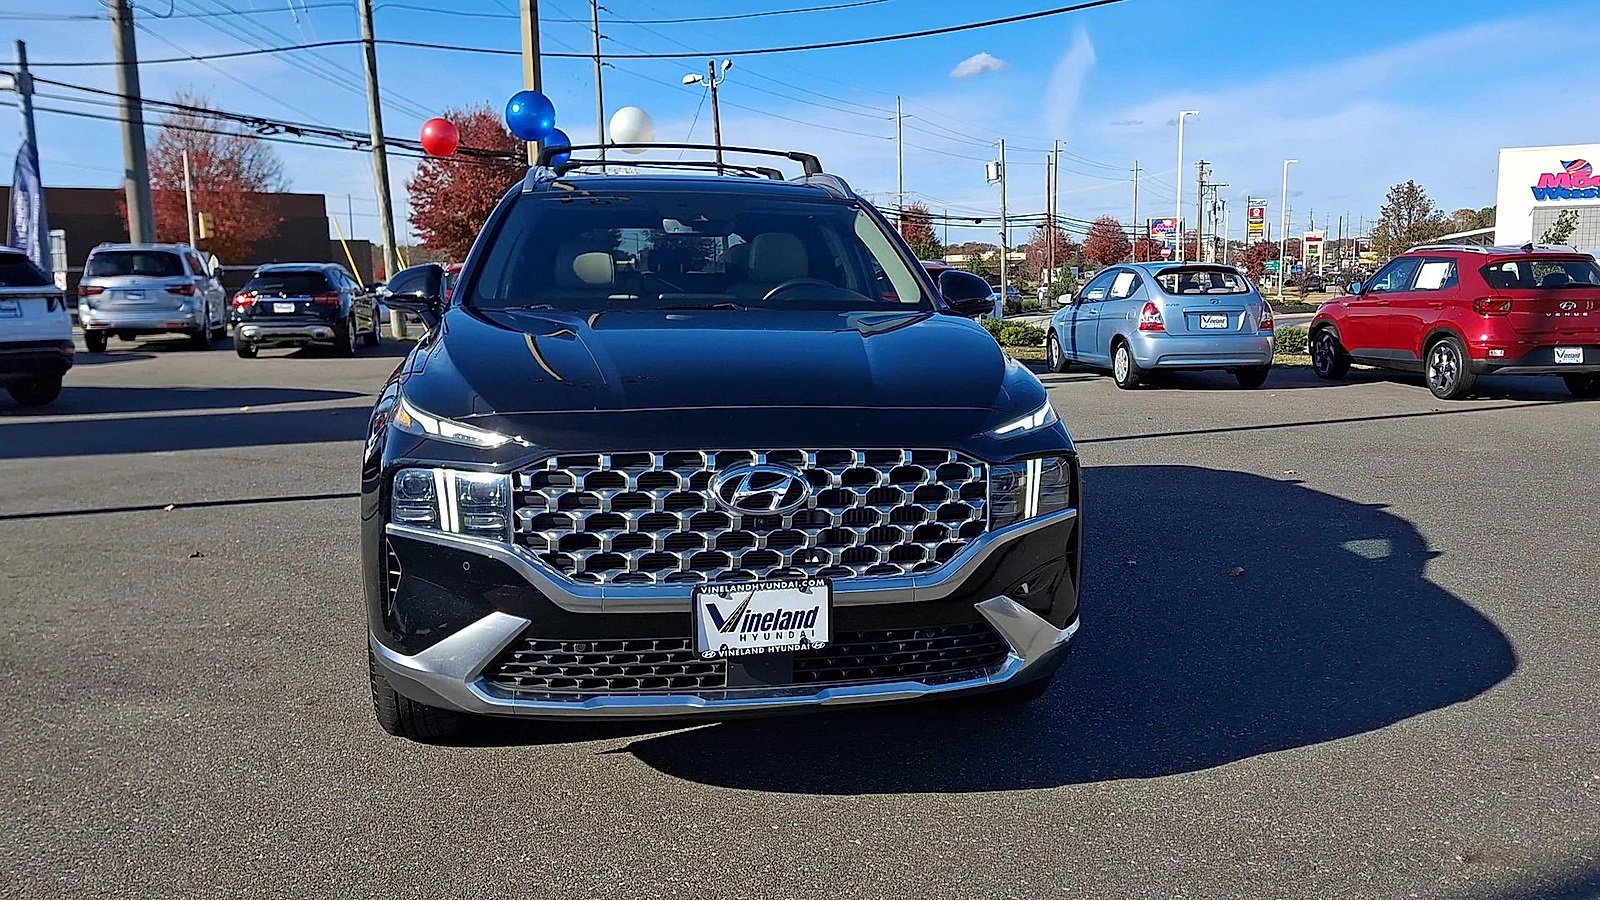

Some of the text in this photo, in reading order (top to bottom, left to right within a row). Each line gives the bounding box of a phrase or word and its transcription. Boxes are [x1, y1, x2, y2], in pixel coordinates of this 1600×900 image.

[701, 579, 825, 594] VINELANDHYUNDAI.COM
[705, 591, 820, 633] Vineland
[739, 629, 816, 643] HYUNDAI
[718, 643, 811, 658] VINELAND HYUNDAI
